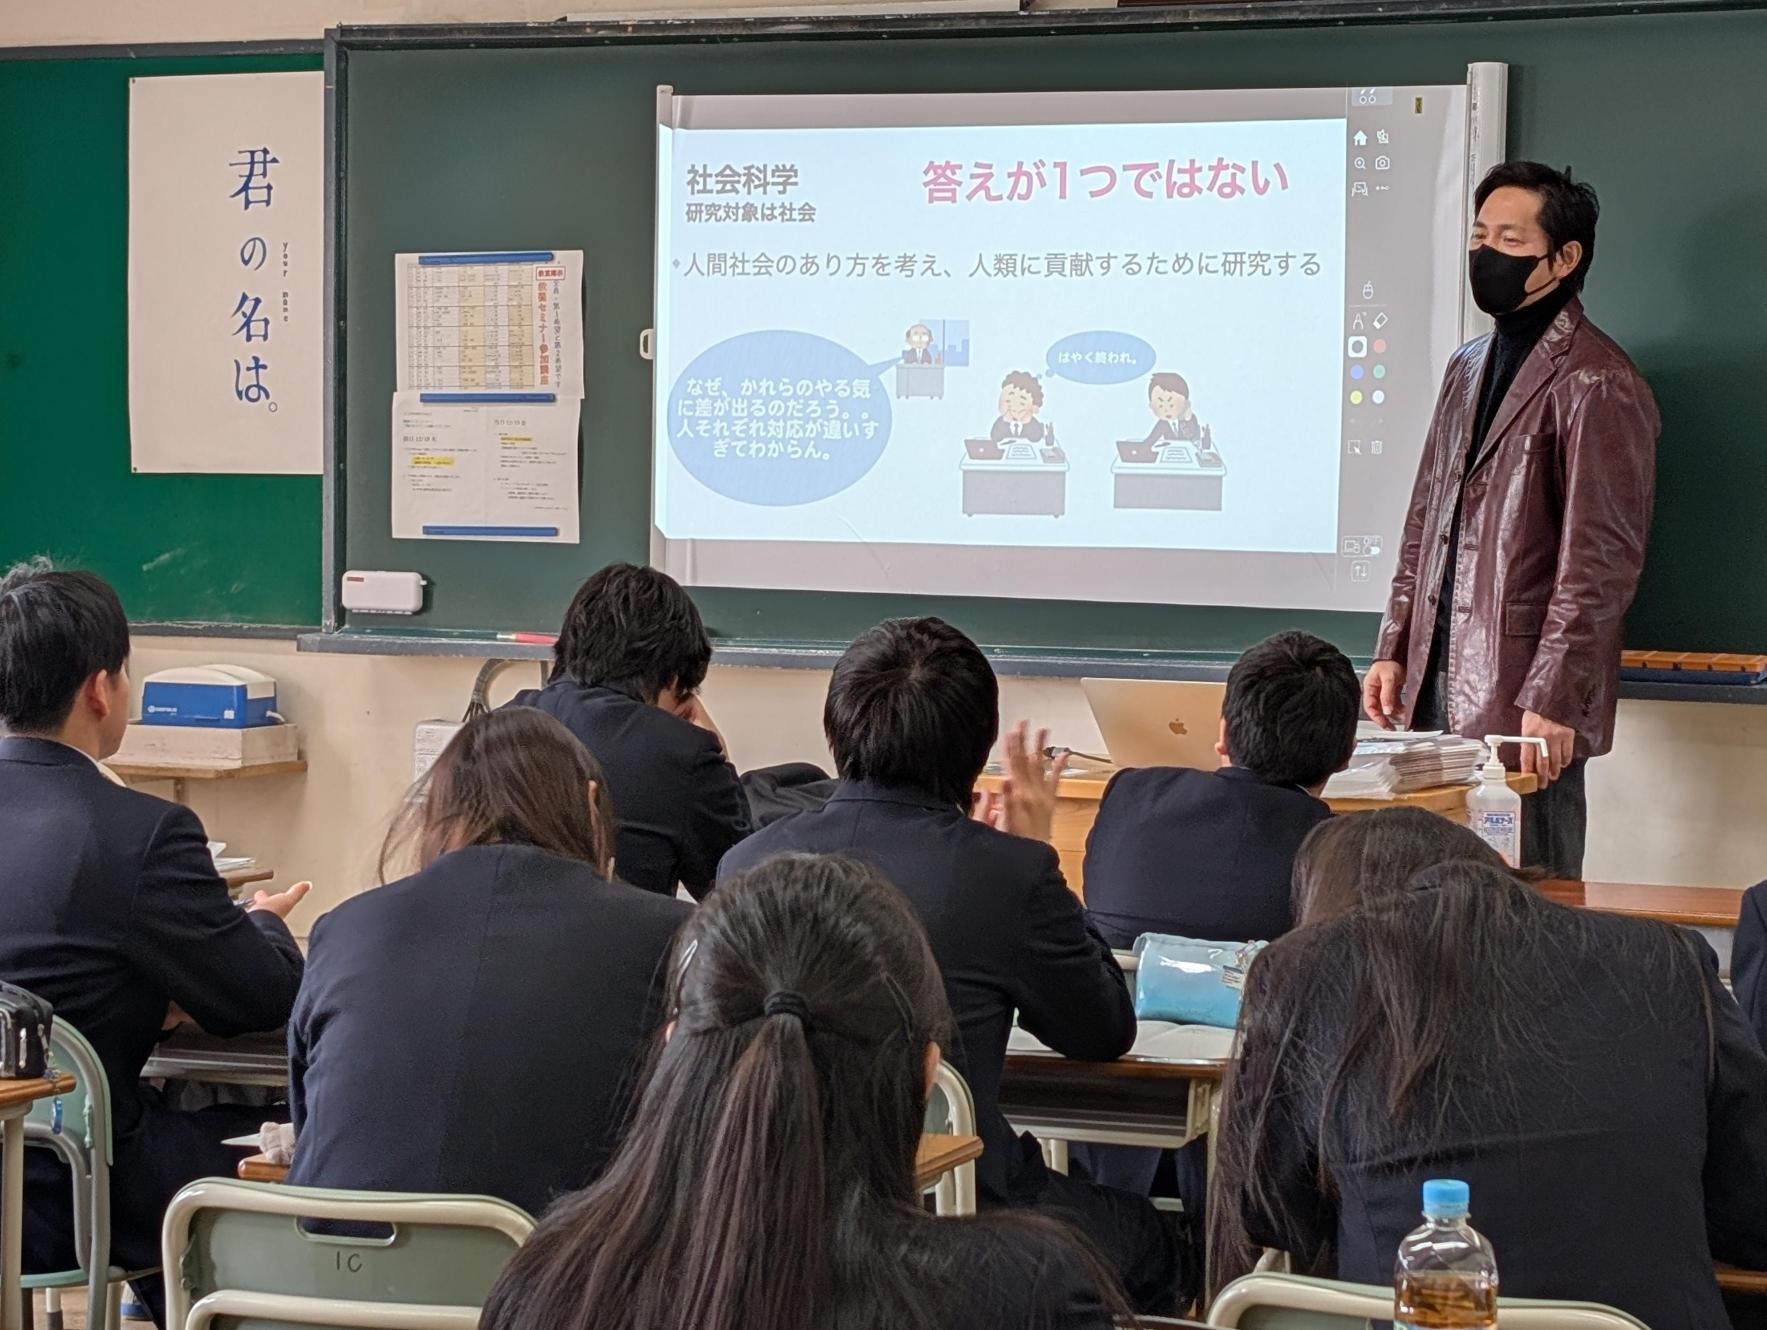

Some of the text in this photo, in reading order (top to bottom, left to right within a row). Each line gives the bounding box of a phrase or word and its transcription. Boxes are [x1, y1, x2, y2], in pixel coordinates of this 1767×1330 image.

[686, 163, 799, 196] 社会科学
[922, 157, 1289, 204] 答えが1つではない
[685, 202, 817, 223] 研究対象は社会
[229, 147, 279, 413] 君の名は。
[677, 418, 880, 440] 人それぞれ対応が違いす
[713, 438, 831, 461] ぎてわからん。
